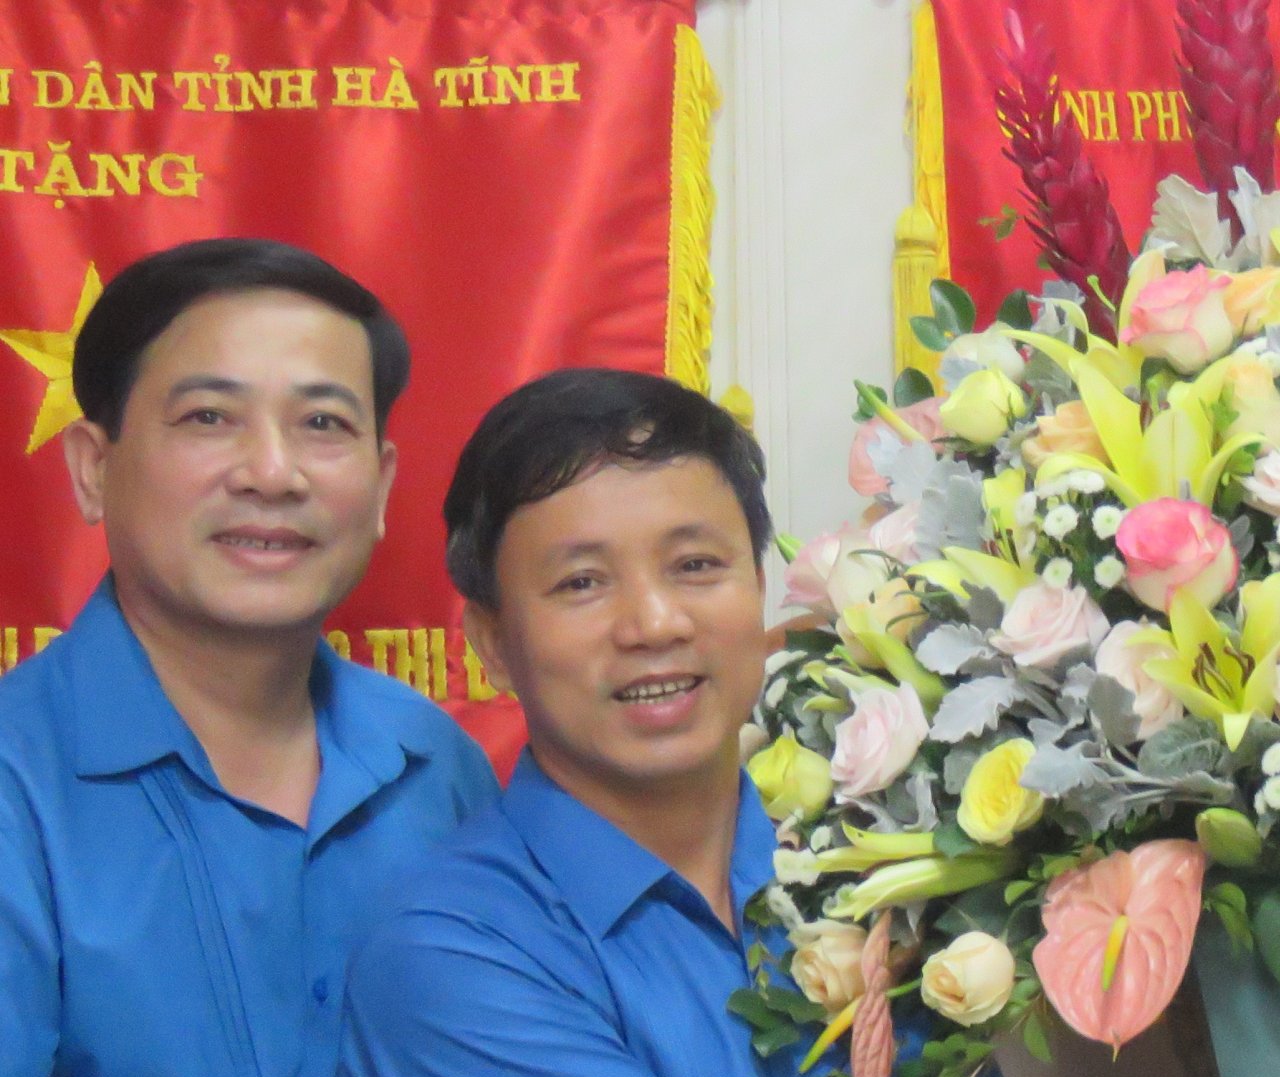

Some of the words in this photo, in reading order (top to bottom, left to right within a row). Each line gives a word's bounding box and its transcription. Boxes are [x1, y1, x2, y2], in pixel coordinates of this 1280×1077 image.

[32, 60, 158, 111] DÂN
[173, 53, 318, 112] TỈNH
[332, 56, 419, 110] HÀ
[433, 55, 581, 108] TĨNH
[1128, 90, 1194, 141] PH
[0, 141, 204, 209] TẶNG
